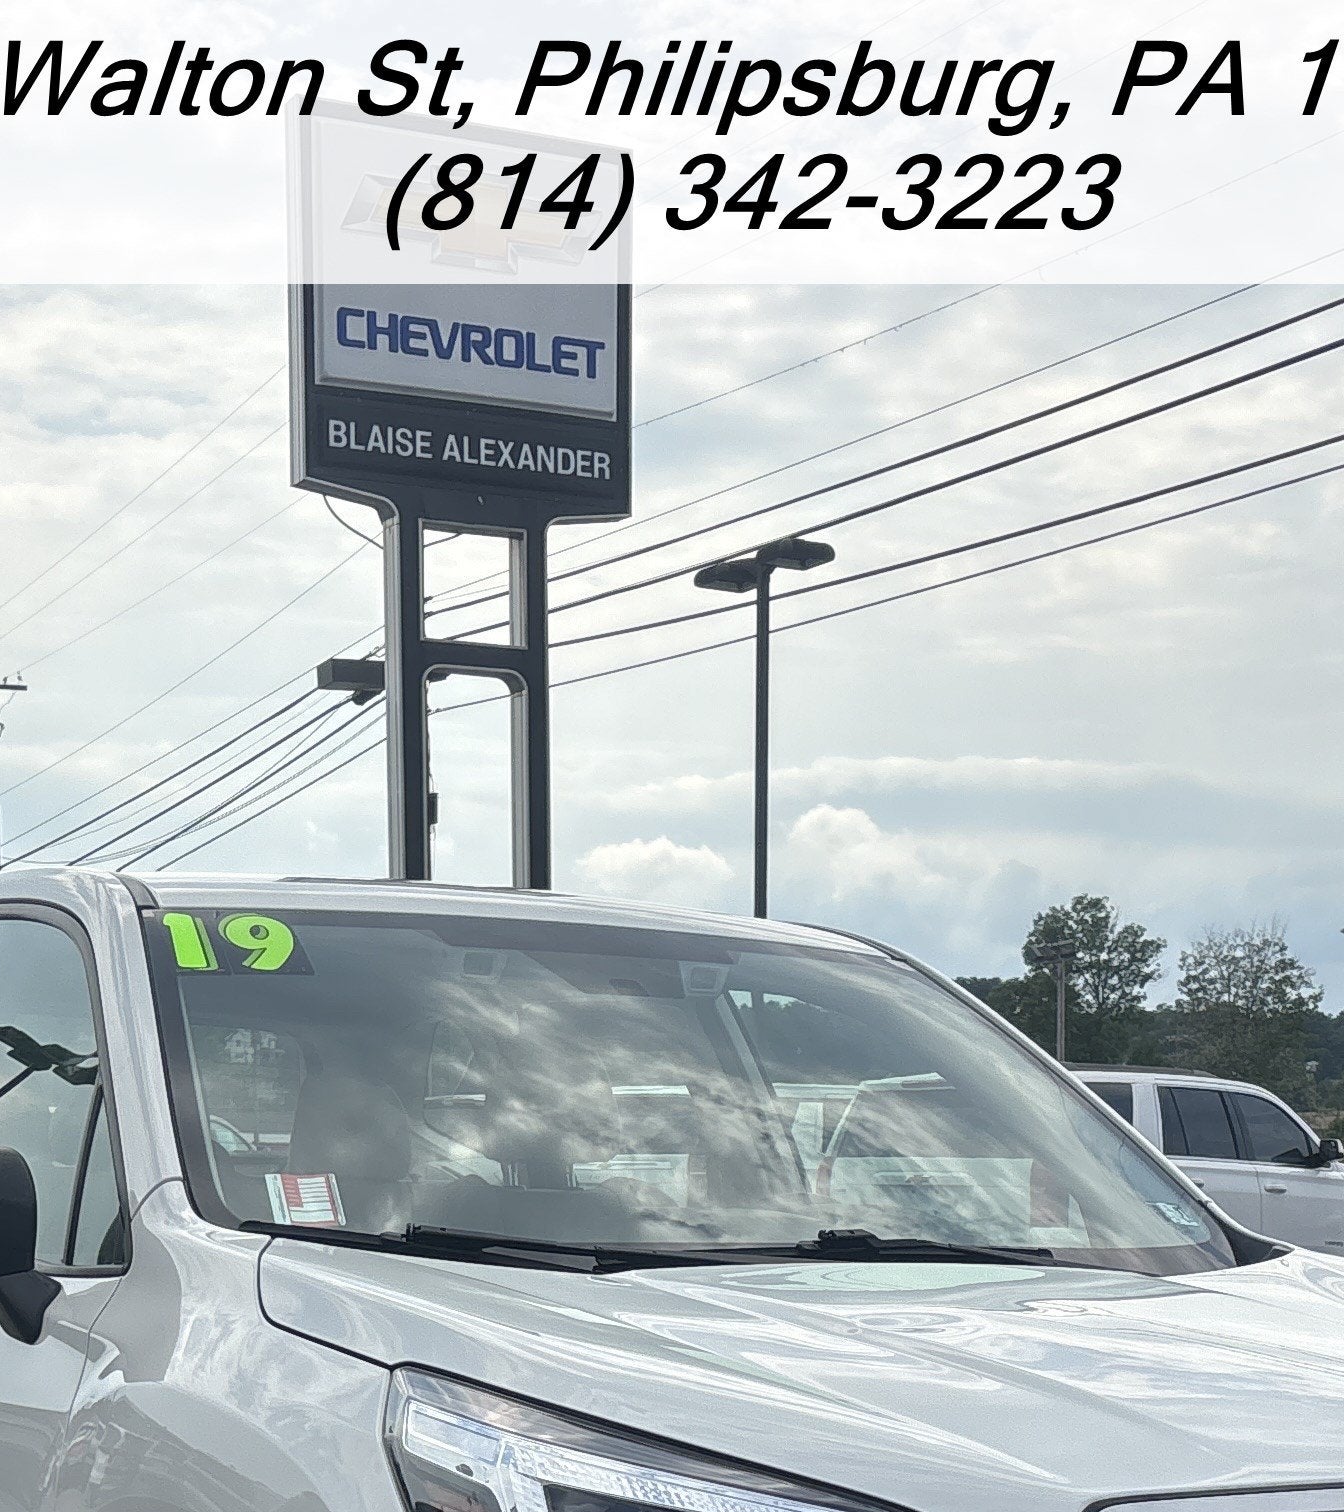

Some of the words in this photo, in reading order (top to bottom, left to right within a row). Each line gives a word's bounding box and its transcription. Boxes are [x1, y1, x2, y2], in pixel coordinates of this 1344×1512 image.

[336, 306, 606, 379] CHEVROLET
[327, 419, 433, 460] BLAISE
[442, 432, 611, 480] ALEXANDER
[162, 912, 294, 971] 19
